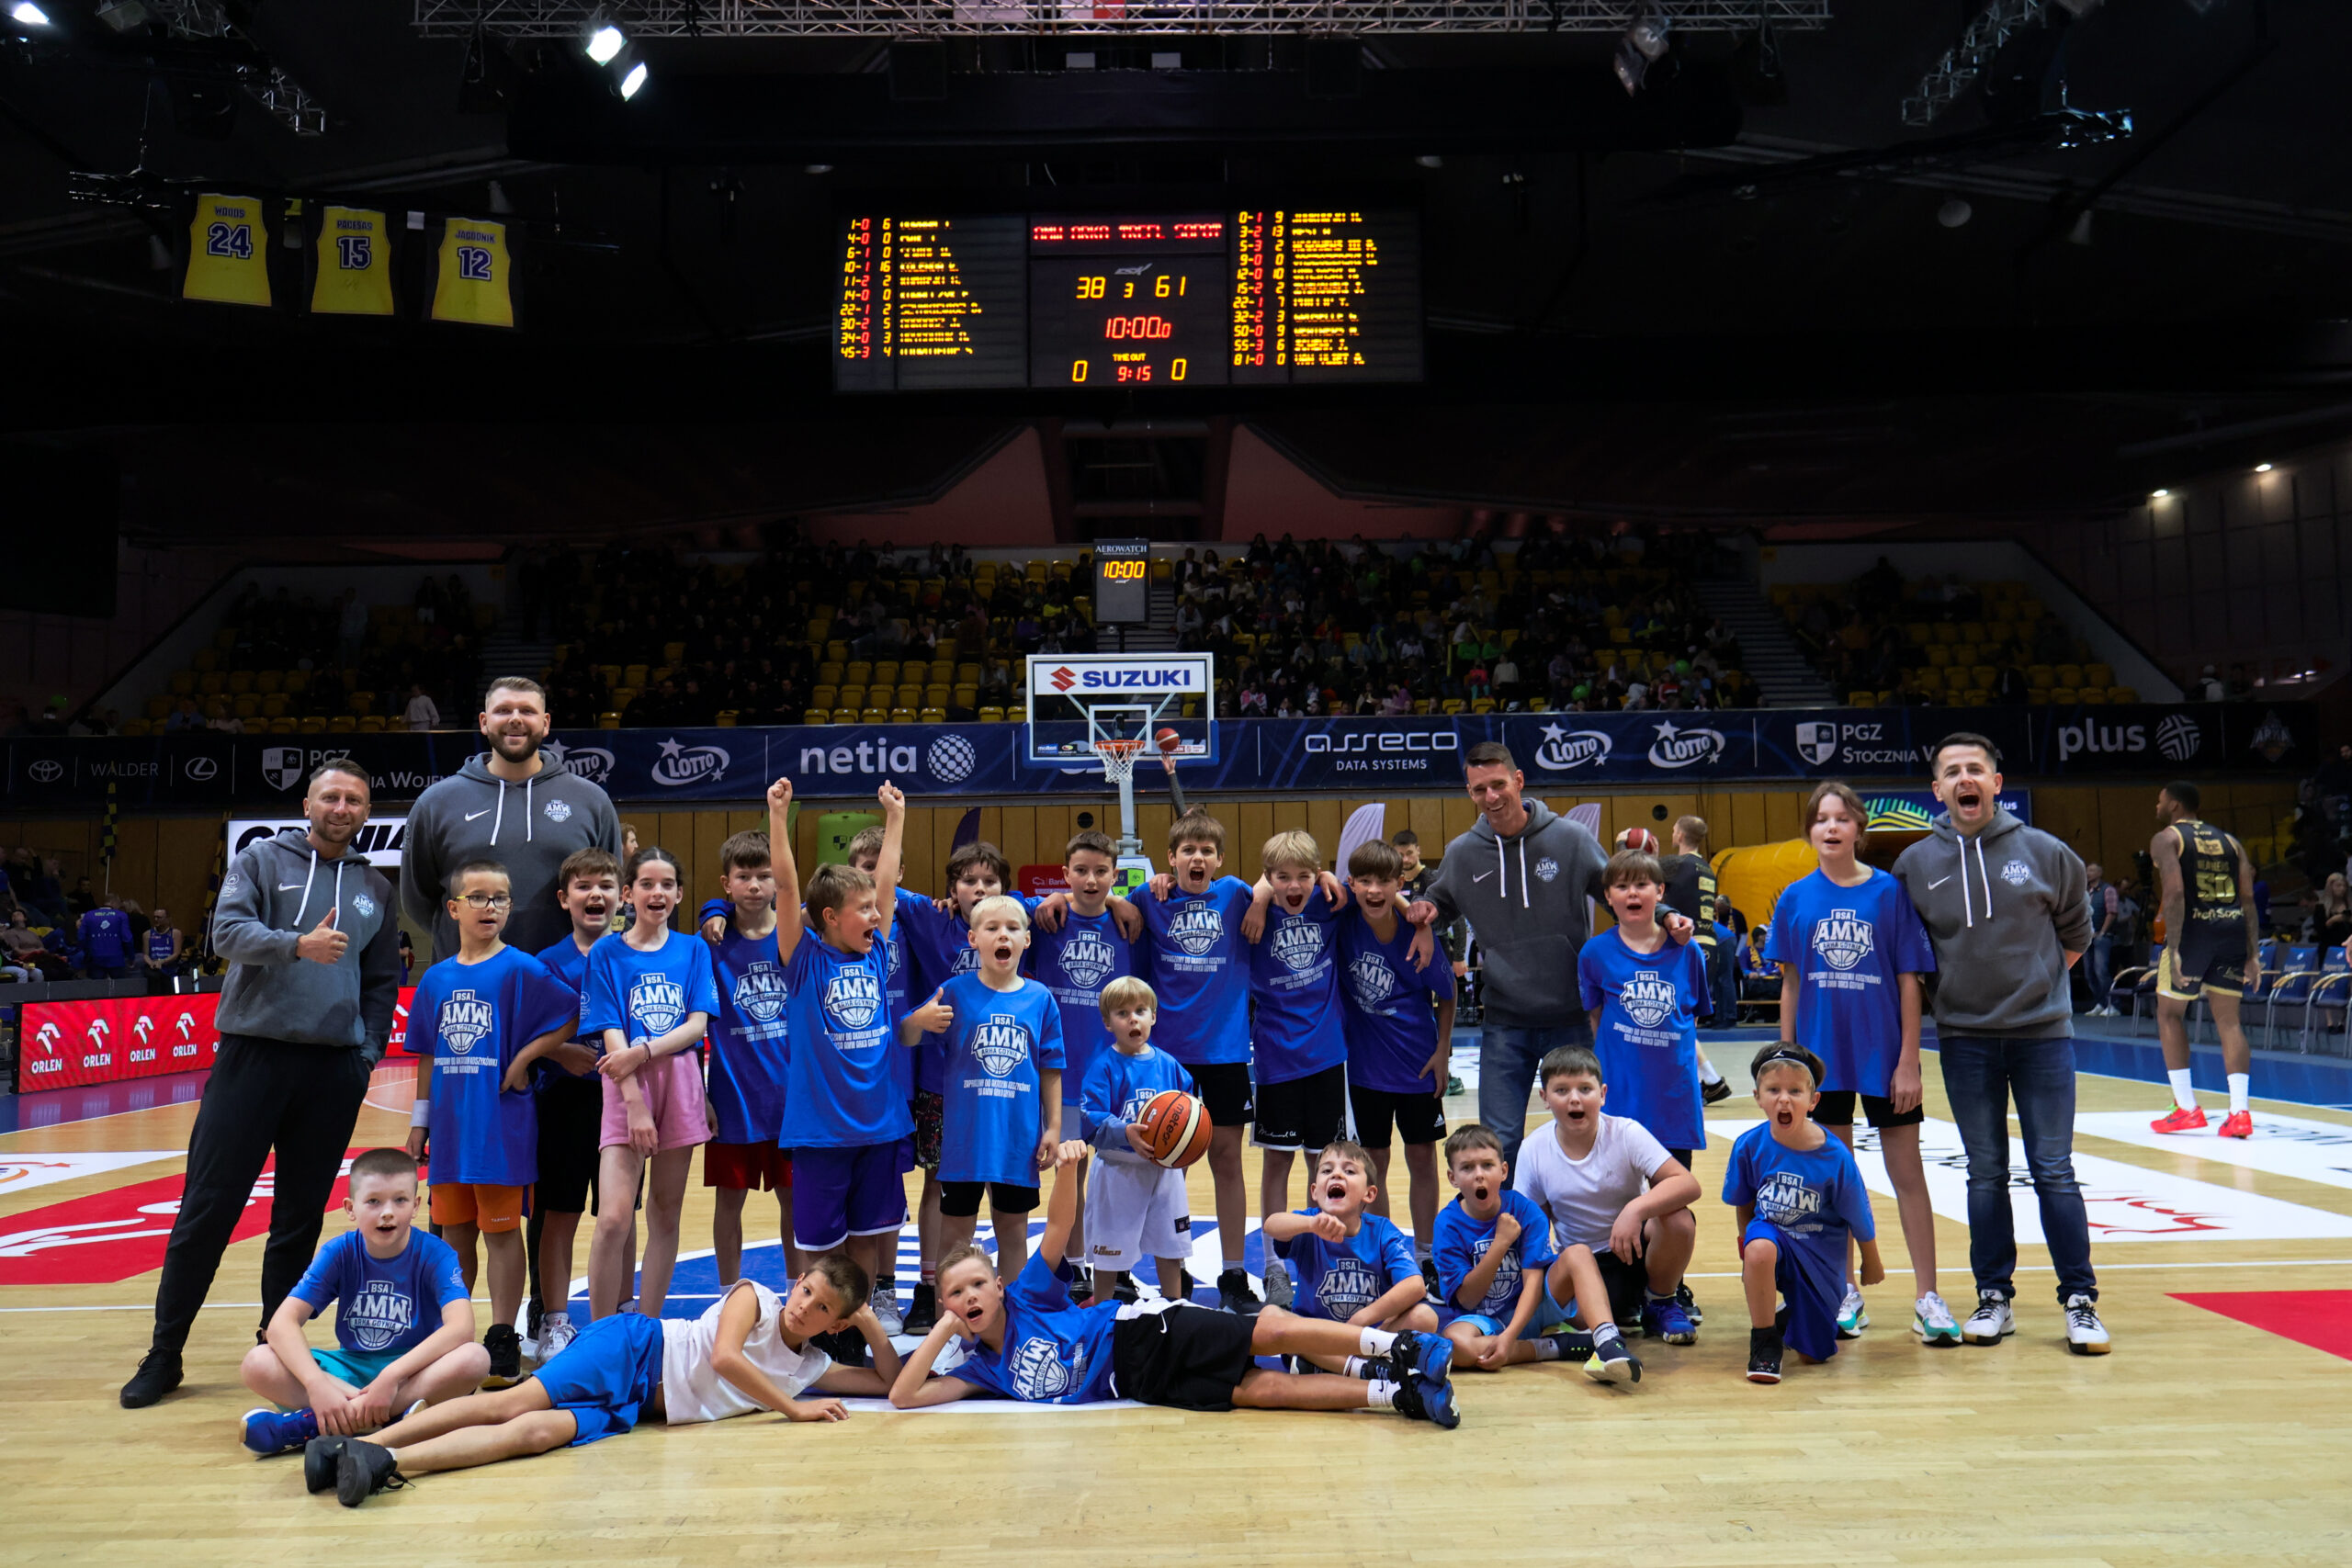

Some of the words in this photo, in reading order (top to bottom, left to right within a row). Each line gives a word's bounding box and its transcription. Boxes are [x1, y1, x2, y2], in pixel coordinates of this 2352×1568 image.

[214, 205, 245, 220] WOODS
[1274, 211, 1284, 223] 9
[882, 219, 891, 231] 6
[1272, 225, 1284, 238] 13
[207, 221, 253, 260] 24
[883, 232, 891, 244] 0
[1274, 239, 1284, 252] 2
[336, 235, 372, 270] 15
[883, 246, 891, 258] 0
[457, 246, 492, 281] 12
[879, 260, 891, 273] 16
[1275, 254, 1284, 266] 0
[883, 275, 891, 287] 2
[1272, 267, 1284, 280] 10
[883, 288, 891, 301] 0
[1076, 276, 1106, 299] 38
[1124, 282, 1134, 299] 3
[1155, 276, 1186, 298] 61
[1275, 282, 1284, 294] 2
[883, 303, 892, 315] 2
[1277, 296, 1285, 309] 7
[883, 317, 891, 329] 5
[1276, 310, 1285, 322] 3
[883, 332, 891, 344] 3
[1276, 324, 1285, 337] 9
[883, 346, 892, 357] 4
[1276, 338, 1285, 352] 6
[1112, 354, 1129, 362] TIME
[1130, 353, 1147, 362] OUT
[1276, 353, 1285, 366] 0
[1072, 360, 1088, 382] 0
[1117, 365, 1152, 382] 9:15
[1170, 358, 1187, 381] 0
[1095, 545, 1148, 553] AEROWATCH
[1103, 560, 1146, 579] 10:00
[1082, 669, 1191, 687] SUZUKI
[1842, 724, 1882, 741] PGZ
[2058, 717, 2146, 761] plus
[1305, 732, 1458, 752] asseco
[1550, 738, 1598, 761] LOTTO
[1664, 736, 1711, 760] LOTTO
[800, 738, 917, 774] netia
[1842, 746, 1919, 763] STOCZNIA
[91, 762, 159, 777] WALDER
[563, 754, 601, 775] OTTO
[669, 750, 715, 780] LOTTO
[1336, 760, 1370, 772] DATA
[1374, 758, 1428, 771] SYSTEMS
[546, 804, 571, 813] AMW
[1535, 862, 1557, 873] AMW
[2003, 864, 2030, 876] AMW
[1048, 877, 1067, 886] Bank
[2195, 872, 2236, 904] 50
[1170, 911, 1220, 933] AMW
[1836, 911, 1851, 919] BSA
[1286, 919, 1300, 928] BSA
[1081, 933, 1096, 942] BSA
[1273, 926, 1321, 952] AMW
[1815, 920, 1870, 945] AMW
[1062, 942, 1112, 966] AMW
[1365, 954, 1380, 964] BSA
[753, 964, 768, 973] BSA
[843, 968, 860, 976] BSA
[1349, 961, 1392, 990] AMW
[646, 976, 662, 984] BSA
[1639, 973, 1655, 981] BSA
[737, 973, 787, 998] AMW
[827, 978, 880, 1004] AMW
[631, 985, 681, 1010] AMW
[1622, 982, 1673, 1005] AMW
[442, 1002, 489, 1027] AMW
[995, 1017, 1011, 1025] BSA
[974, 1026, 1025, 1055] AMW
[130, 1047, 156, 1063] ORLEN
[173, 1043, 198, 1056] ORLEN
[31, 1057, 62, 1075] ORLEN
[83, 1050, 111, 1068] ORLEN
[1162, 1103, 1184, 1146] meteor
[1781, 1175, 1798, 1186] BSA
[1759, 1181, 1817, 1213] AMW
[1340, 1260, 1356, 1270] BSA
[371, 1283, 389, 1293] BSA
[1319, 1277, 1377, 1298] AMW
[349, 1294, 408, 1324] AMW
[1012, 1352, 1021, 1369] BSA
[1016, 1339, 1052, 1400] AMW
